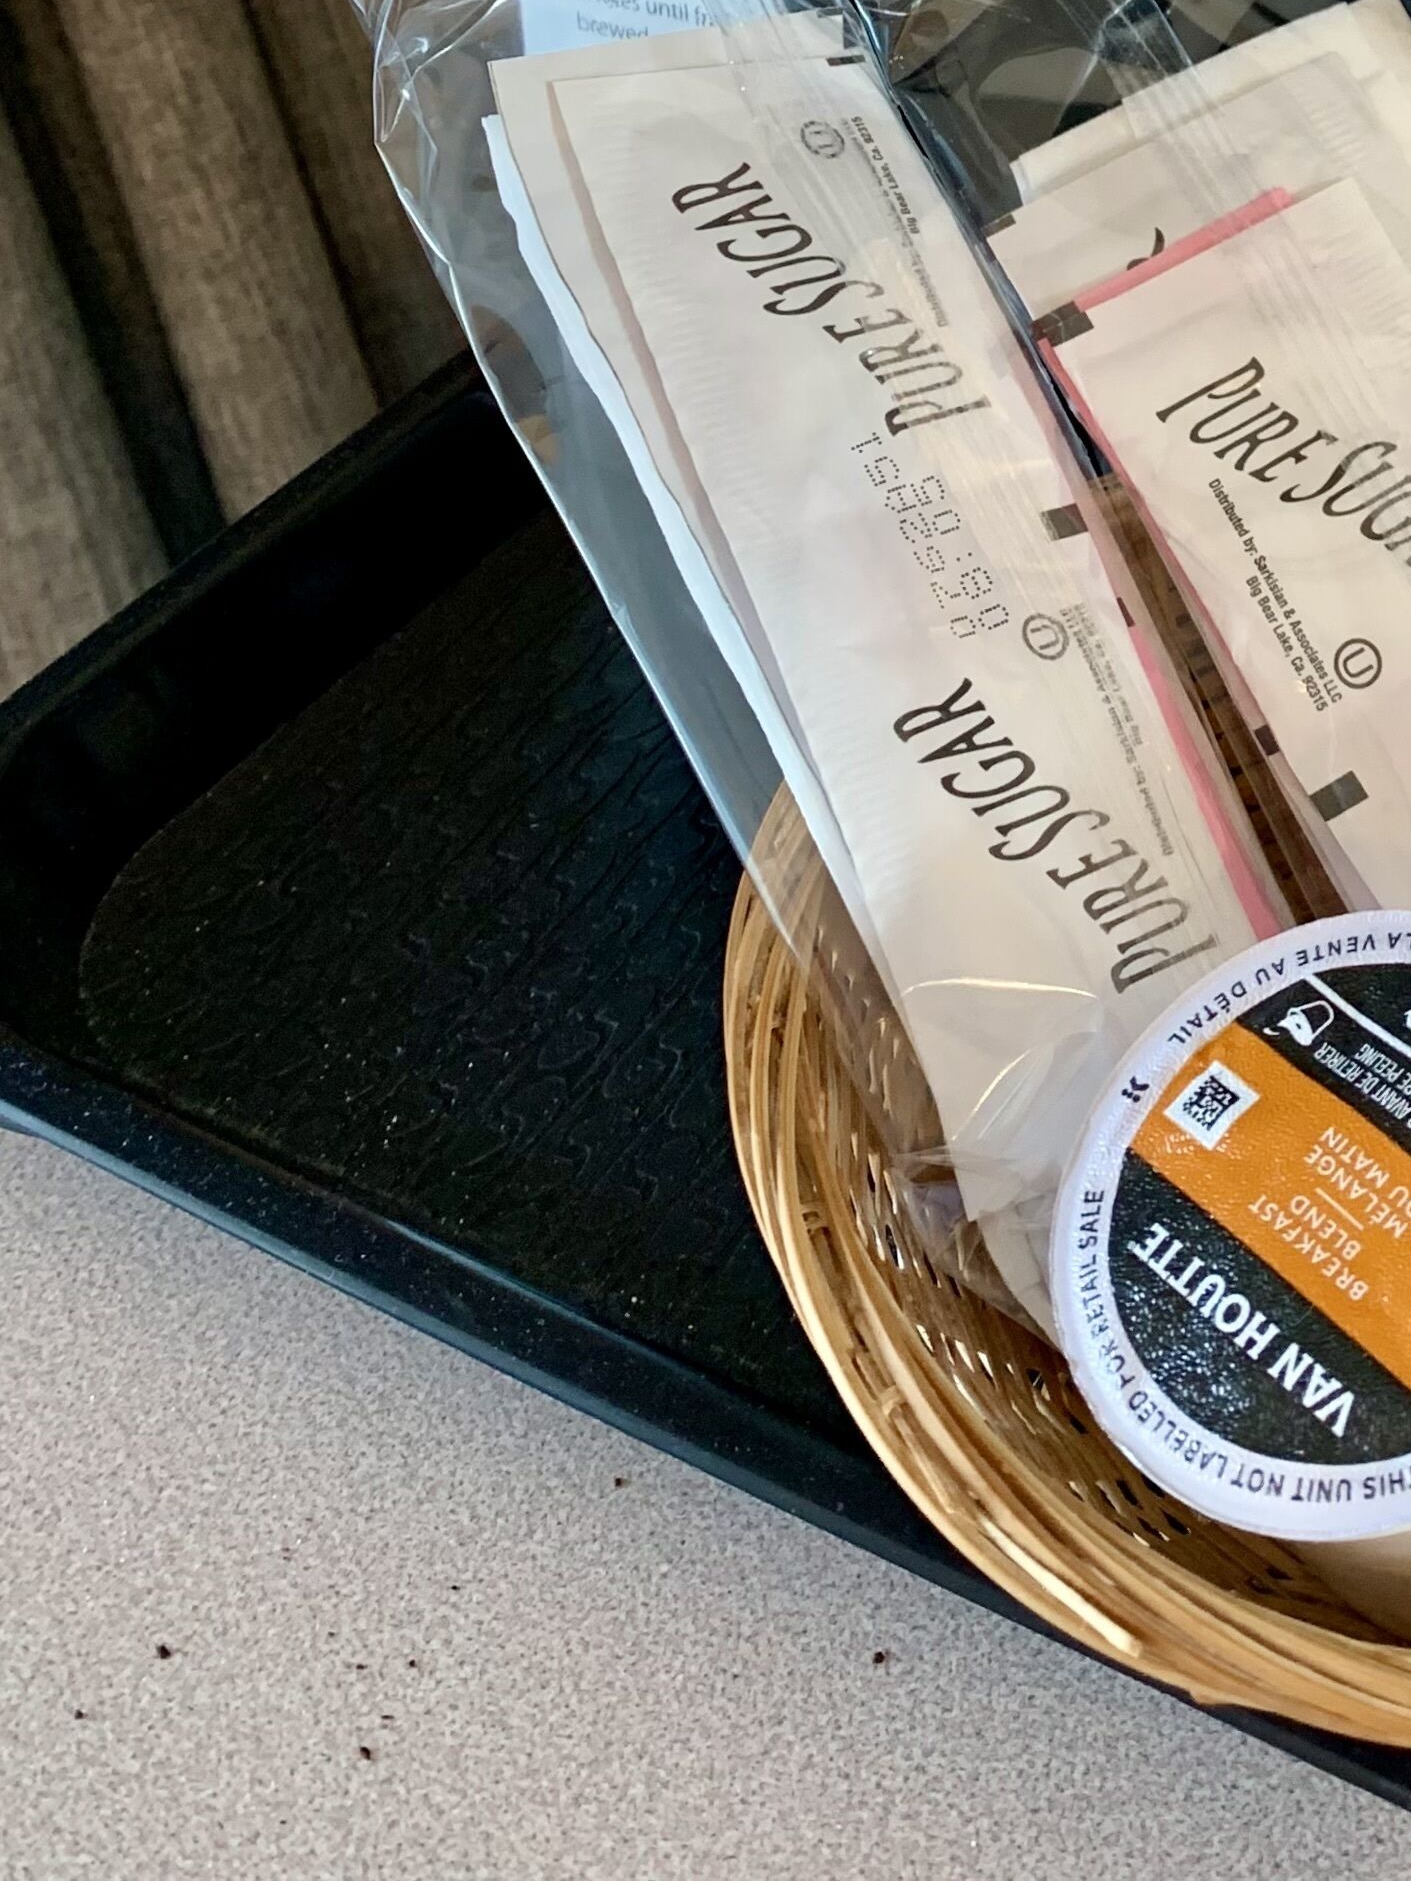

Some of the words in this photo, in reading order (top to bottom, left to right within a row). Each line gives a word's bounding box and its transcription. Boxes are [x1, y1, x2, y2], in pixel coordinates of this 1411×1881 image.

[646, 0, 689, 22] until
[672, 162, 885, 316] SUGAR
[822, 308, 992, 437] PURE
[1156, 357, 1338, 482] PURE
[1209, 478, 1249, 538] Distributed
[1243, 531, 1259, 557] by:
[1254, 554, 1288, 609] Sarkisian
[1245, 575, 1262, 598] Big
[1258, 595, 1279, 624] Bear
[1273, 624, 1295, 657] Lake,
[1291, 656, 1305, 676] Ca.
[1302, 674, 1329, 712] 92315
[1283, 608, 1296, 620] &
[1289, 620, 1329, 680] Associates
[1323, 678, 1343, 704] LLC
[893, 677, 1110, 861] SUGAR
[1046, 839, 1218, 994] PURE
[1255, 957, 1286, 986] AU
[1296, 935, 1376, 966] VENTE
[1167, 980, 1248, 1047] DÉTAIL
[1313, 1041, 1362, 1083] RETIRER
[1354, 1043, 1405, 1082] PEELING
[1355, 1071, 1378, 1095] DE
[1320, 1126, 1391, 1189] MATIN
[1078, 1189, 1105, 1249] SALE
[1302, 1142, 1409, 1239] MÉLANGE
[1247, 1194, 1370, 1302] BREAKFAST
[1289, 1195, 1363, 1260] BLEND
[1127, 1221, 1281, 1360] HOUTTE
[1266, 1341, 1355, 1438] VAN
[1128, 1390, 1229, 1471] LABELLED
[1229, 1467, 1285, 1498] NOT
[1291, 1477, 1353, 1503] UNIT
